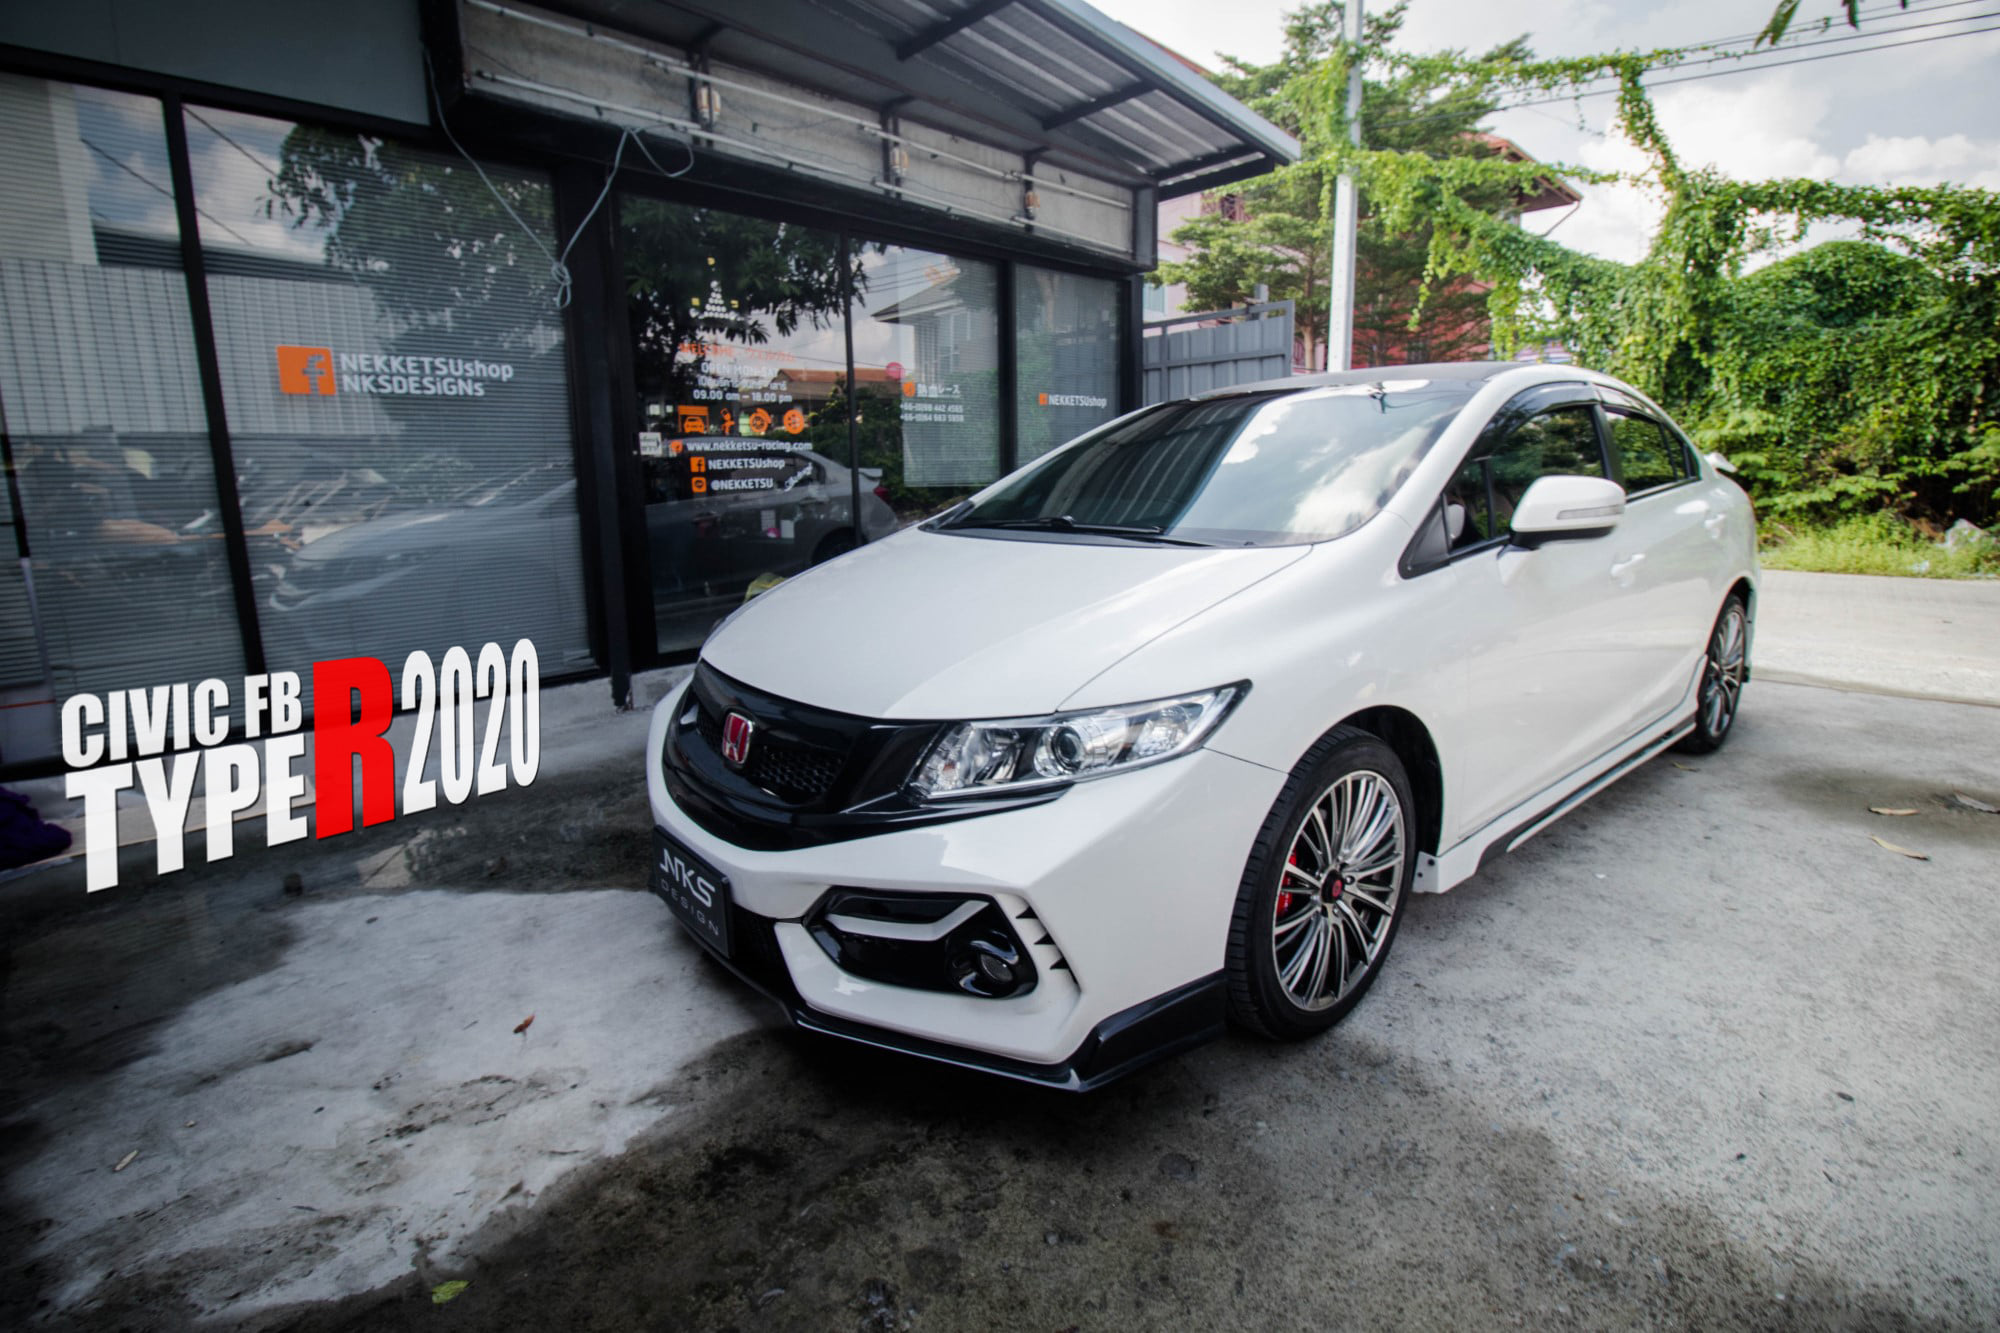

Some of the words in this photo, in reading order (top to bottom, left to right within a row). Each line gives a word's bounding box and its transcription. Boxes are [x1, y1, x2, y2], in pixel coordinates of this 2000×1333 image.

[340, 352, 514, 381] NEKKETSUshop
[693, 388, 724, 400] 09.00
[725, 390, 740, 400] am
[779, 394, 793, 403] pm
[686, 440, 813, 452] www.nekketsu-racing.com
[708, 458, 785, 471] NEKKETSUshop
[711, 478, 774, 491] @NEKKETSU
[659, 848, 716, 908] NKS
[660, 878, 719, 936] DESIGN
